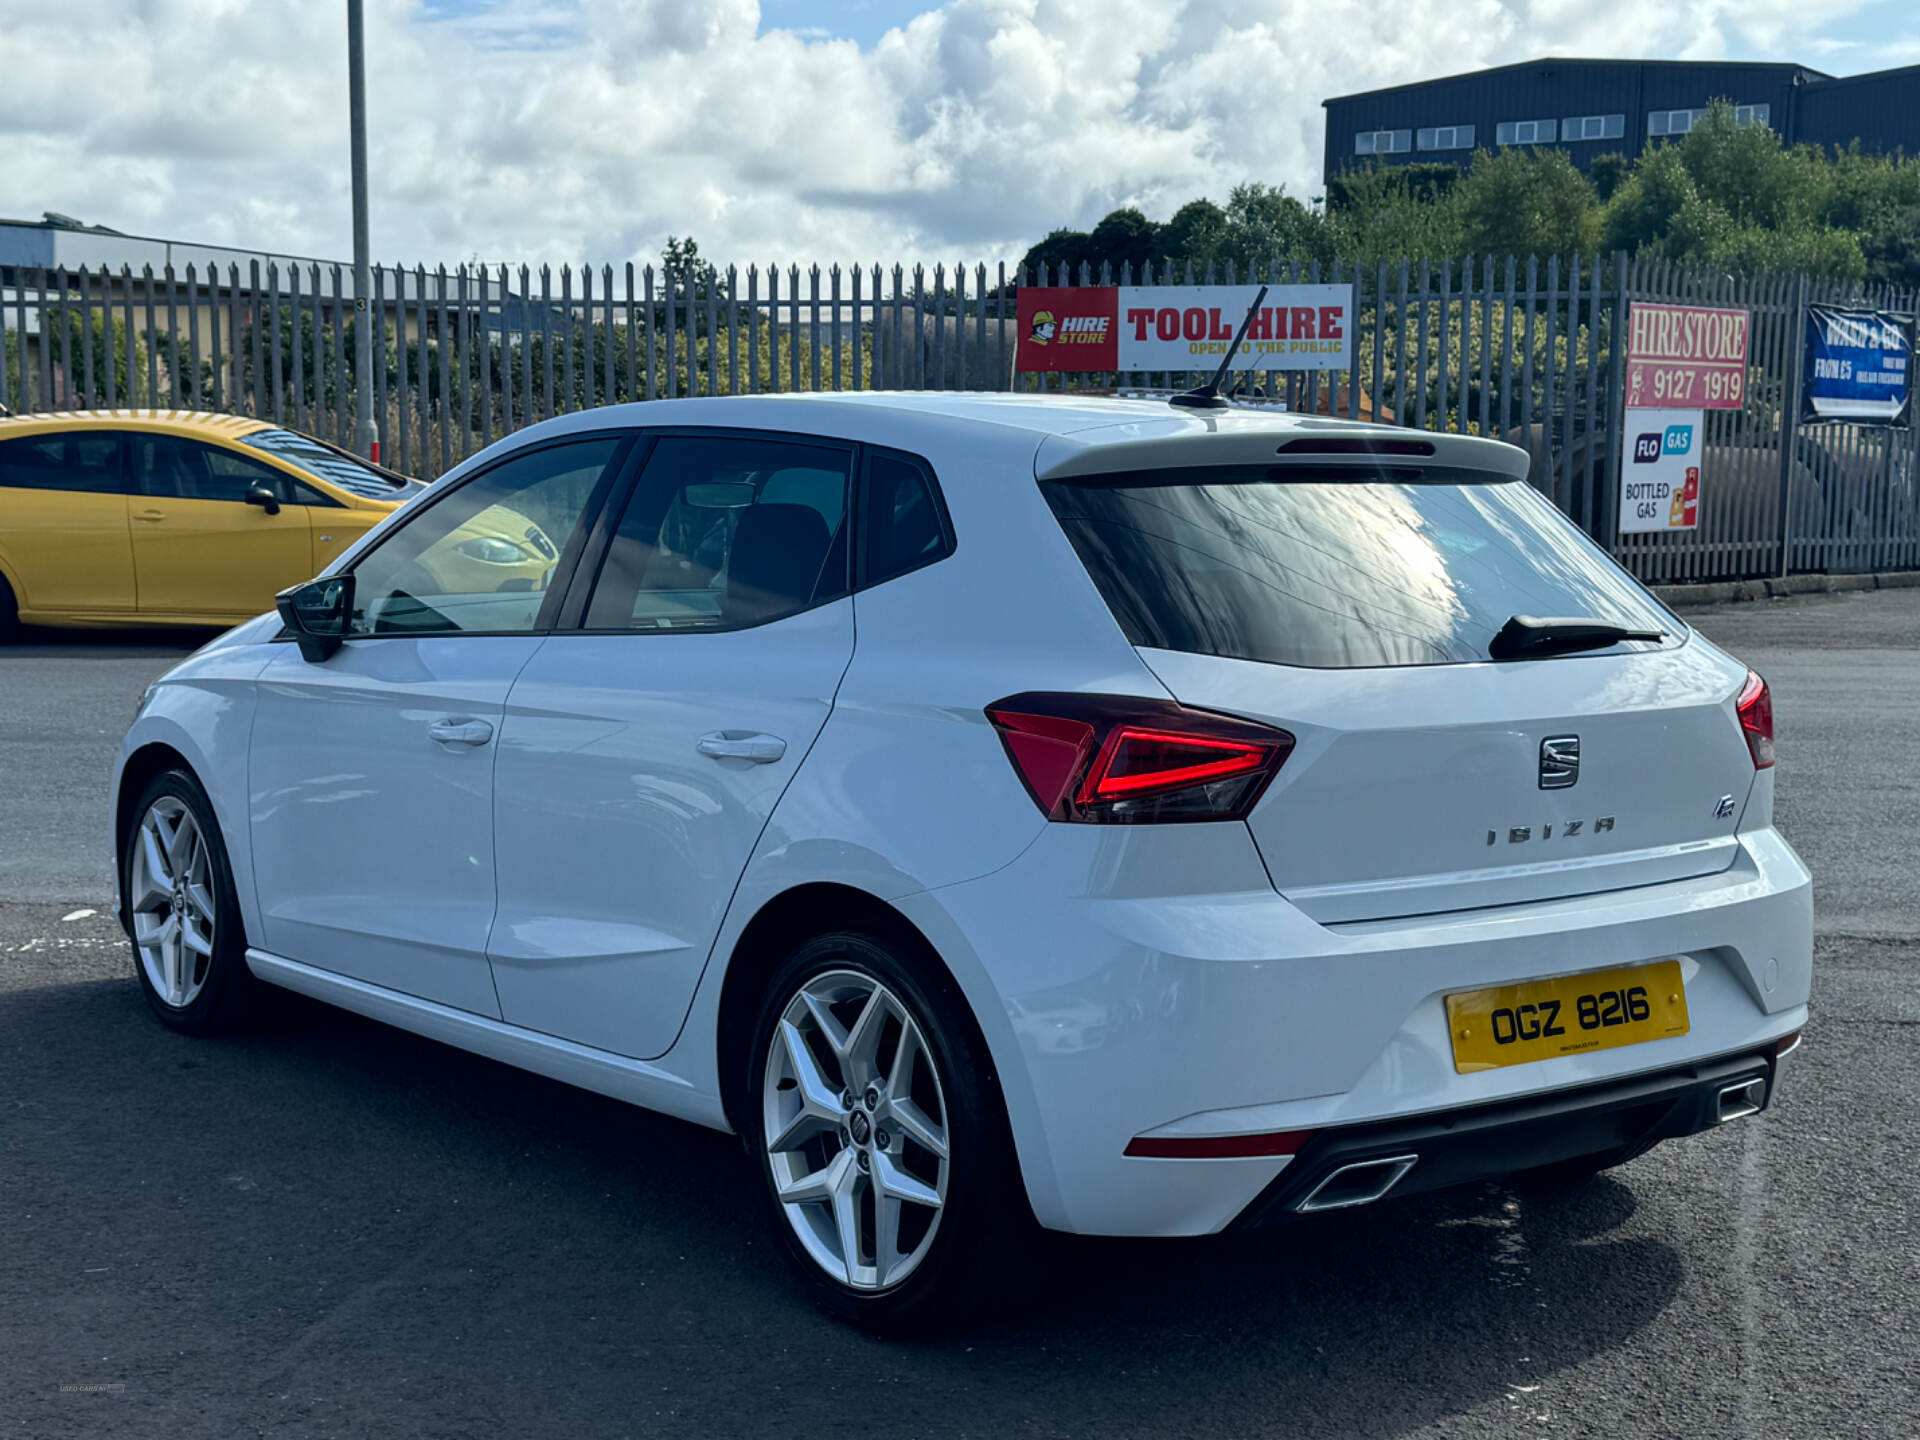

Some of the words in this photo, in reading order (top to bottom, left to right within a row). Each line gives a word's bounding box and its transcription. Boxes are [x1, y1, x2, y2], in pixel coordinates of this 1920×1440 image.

[358, 299, 366, 311] 3
[1061, 317, 1110, 332] HIRE
[1127, 308, 1232, 341] TOOL
[1246, 306, 1343, 340] HIRE
[1058, 332, 1106, 344] STORE
[1189, 342, 1227, 355] OPEN
[1256, 342, 1285, 354] THE
[1290, 341, 1342, 353] PUBLIC
[1654, 369, 1696, 399] 9127
[1704, 371, 1742, 400] 1919
[1638, 439, 1657, 457] FLO
[1667, 432, 1688, 449] GAS
[1626, 482, 1669, 501] BOTTLED
[1637, 502, 1657, 519] GAS
[1487, 816, 1615, 846] IBIZA
[1491, 1000, 1565, 1045] OGZ
[1576, 986, 1650, 1031] 8216
